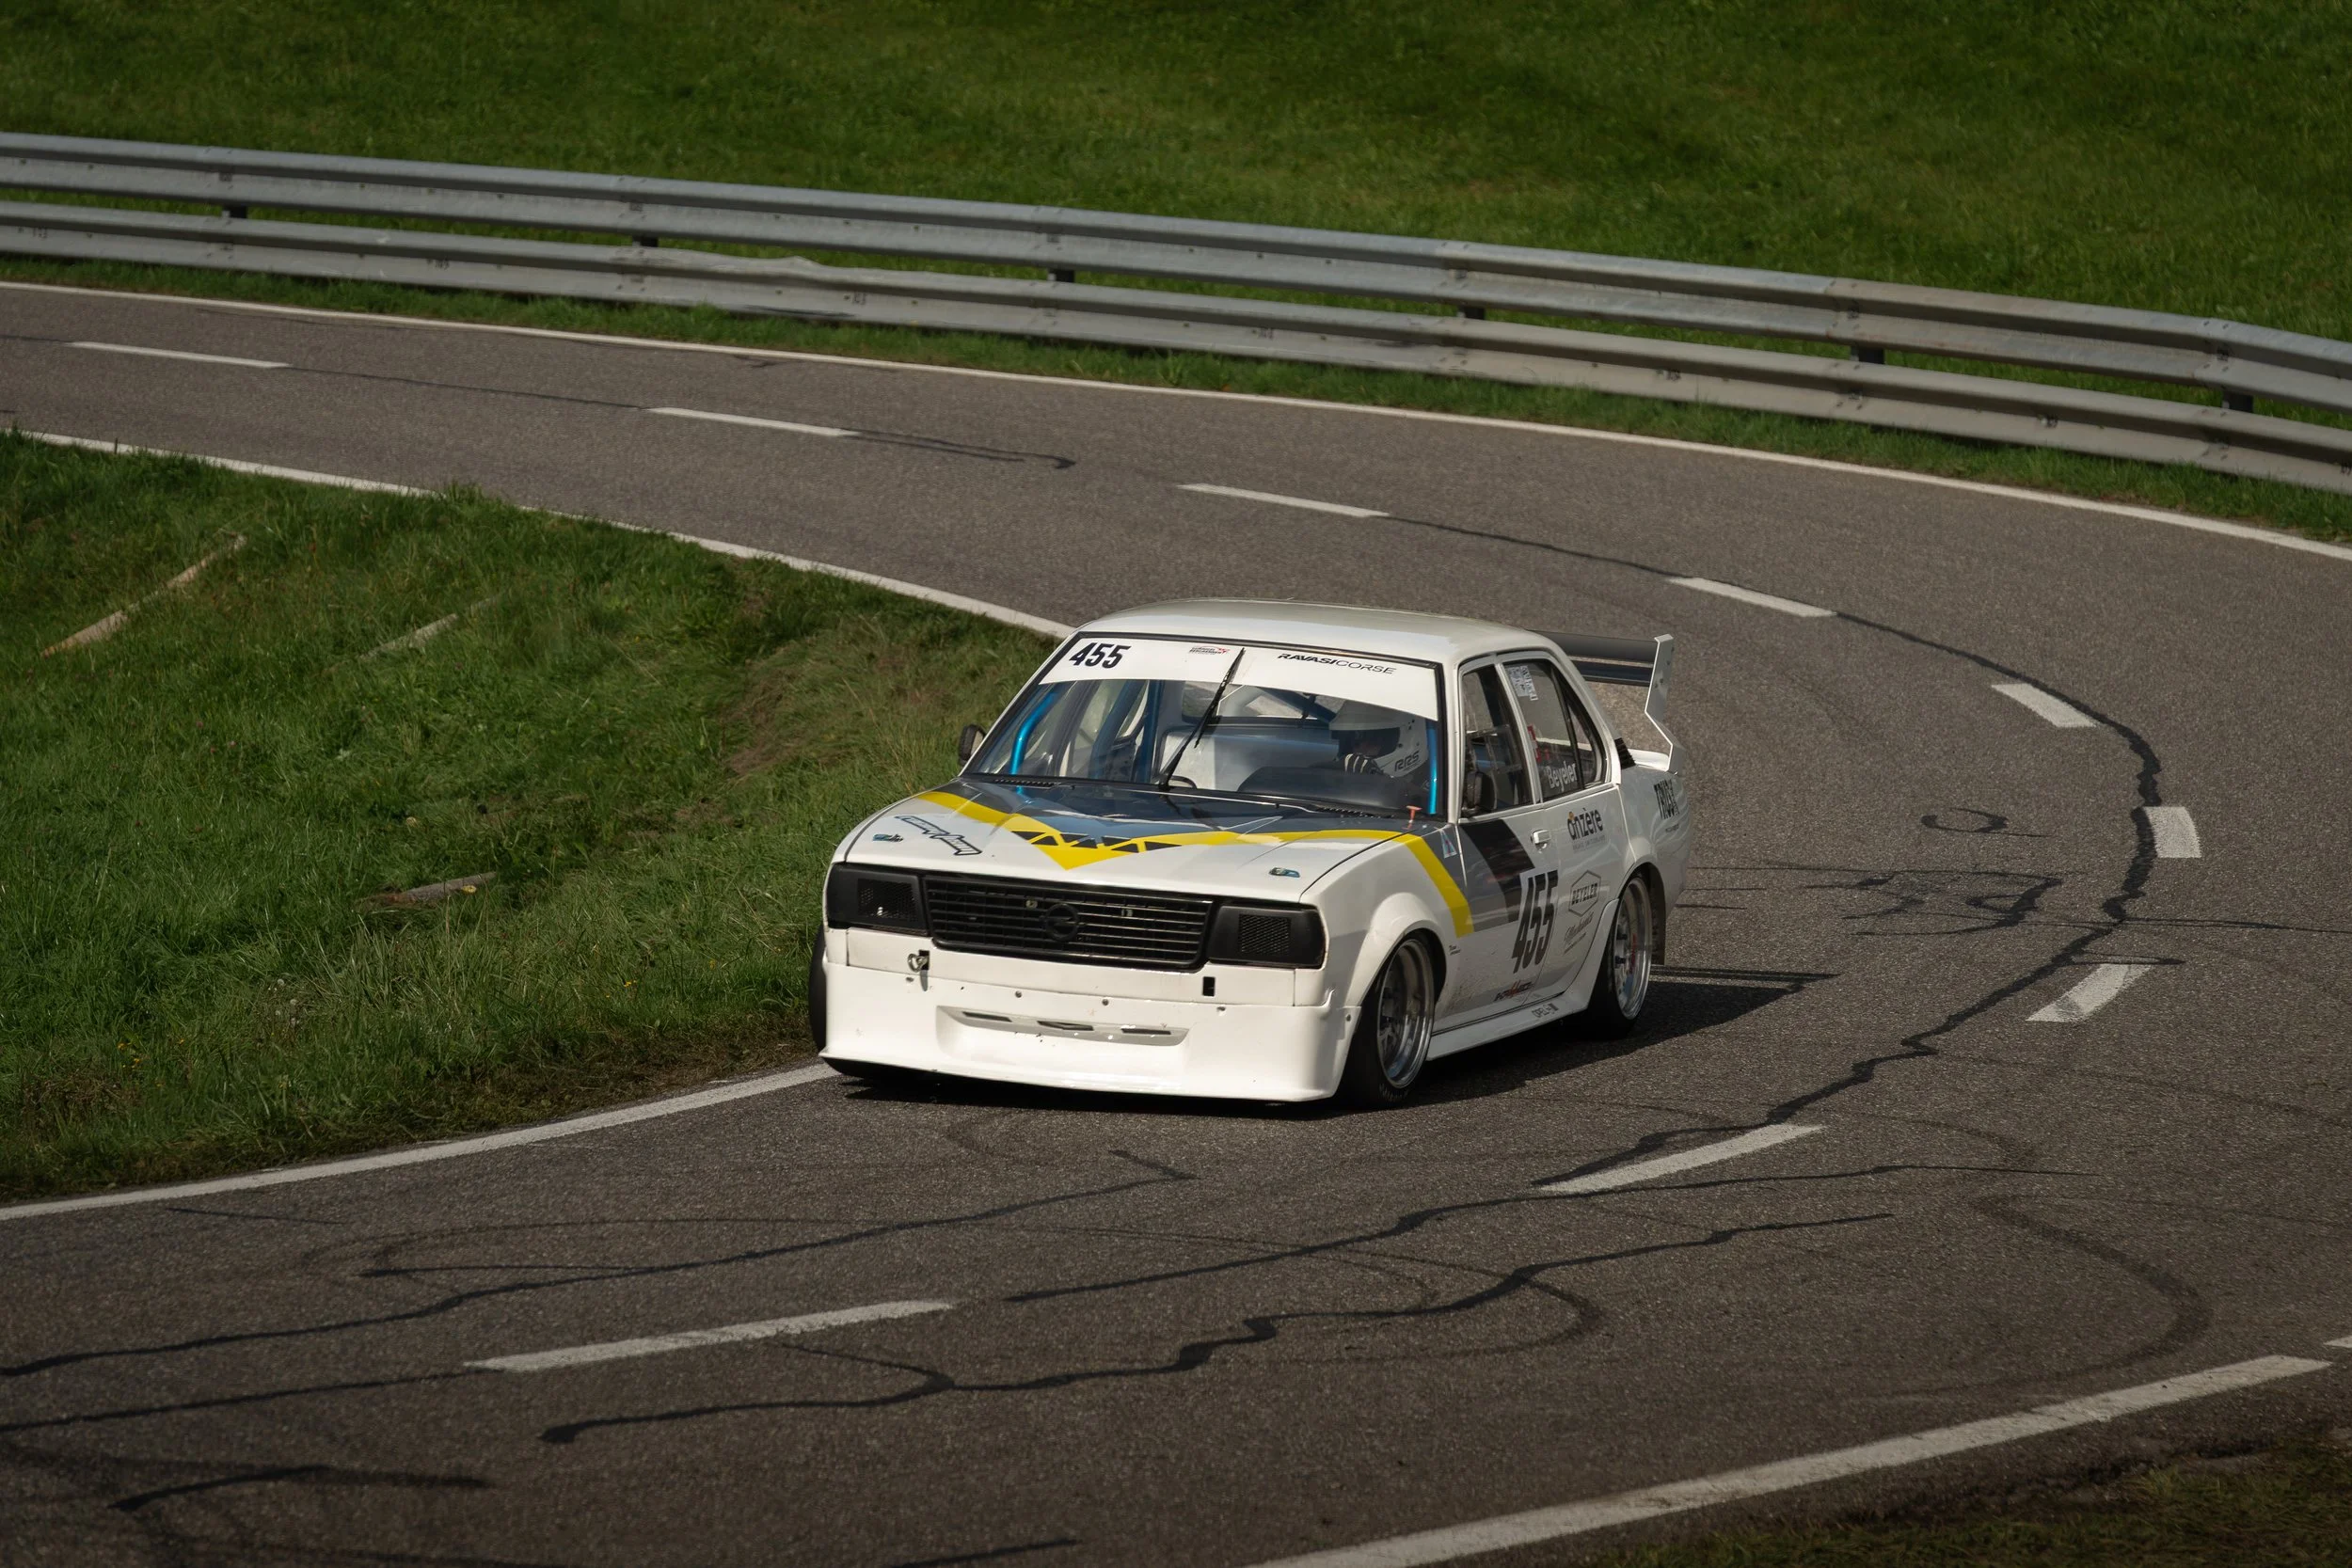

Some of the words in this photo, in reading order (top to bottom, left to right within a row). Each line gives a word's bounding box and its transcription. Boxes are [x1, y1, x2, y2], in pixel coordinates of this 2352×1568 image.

[1069, 642, 1132, 669] 455
[1278, 653, 1397, 674] RAVASICORSE
[1394, 750, 1420, 772] RRS
[1547, 760, 1577, 792] Beyeler
[1567, 808, 1603, 840] anzère
[1571, 882, 1598, 906] BEYELER
[1512, 870, 1558, 974] 455
